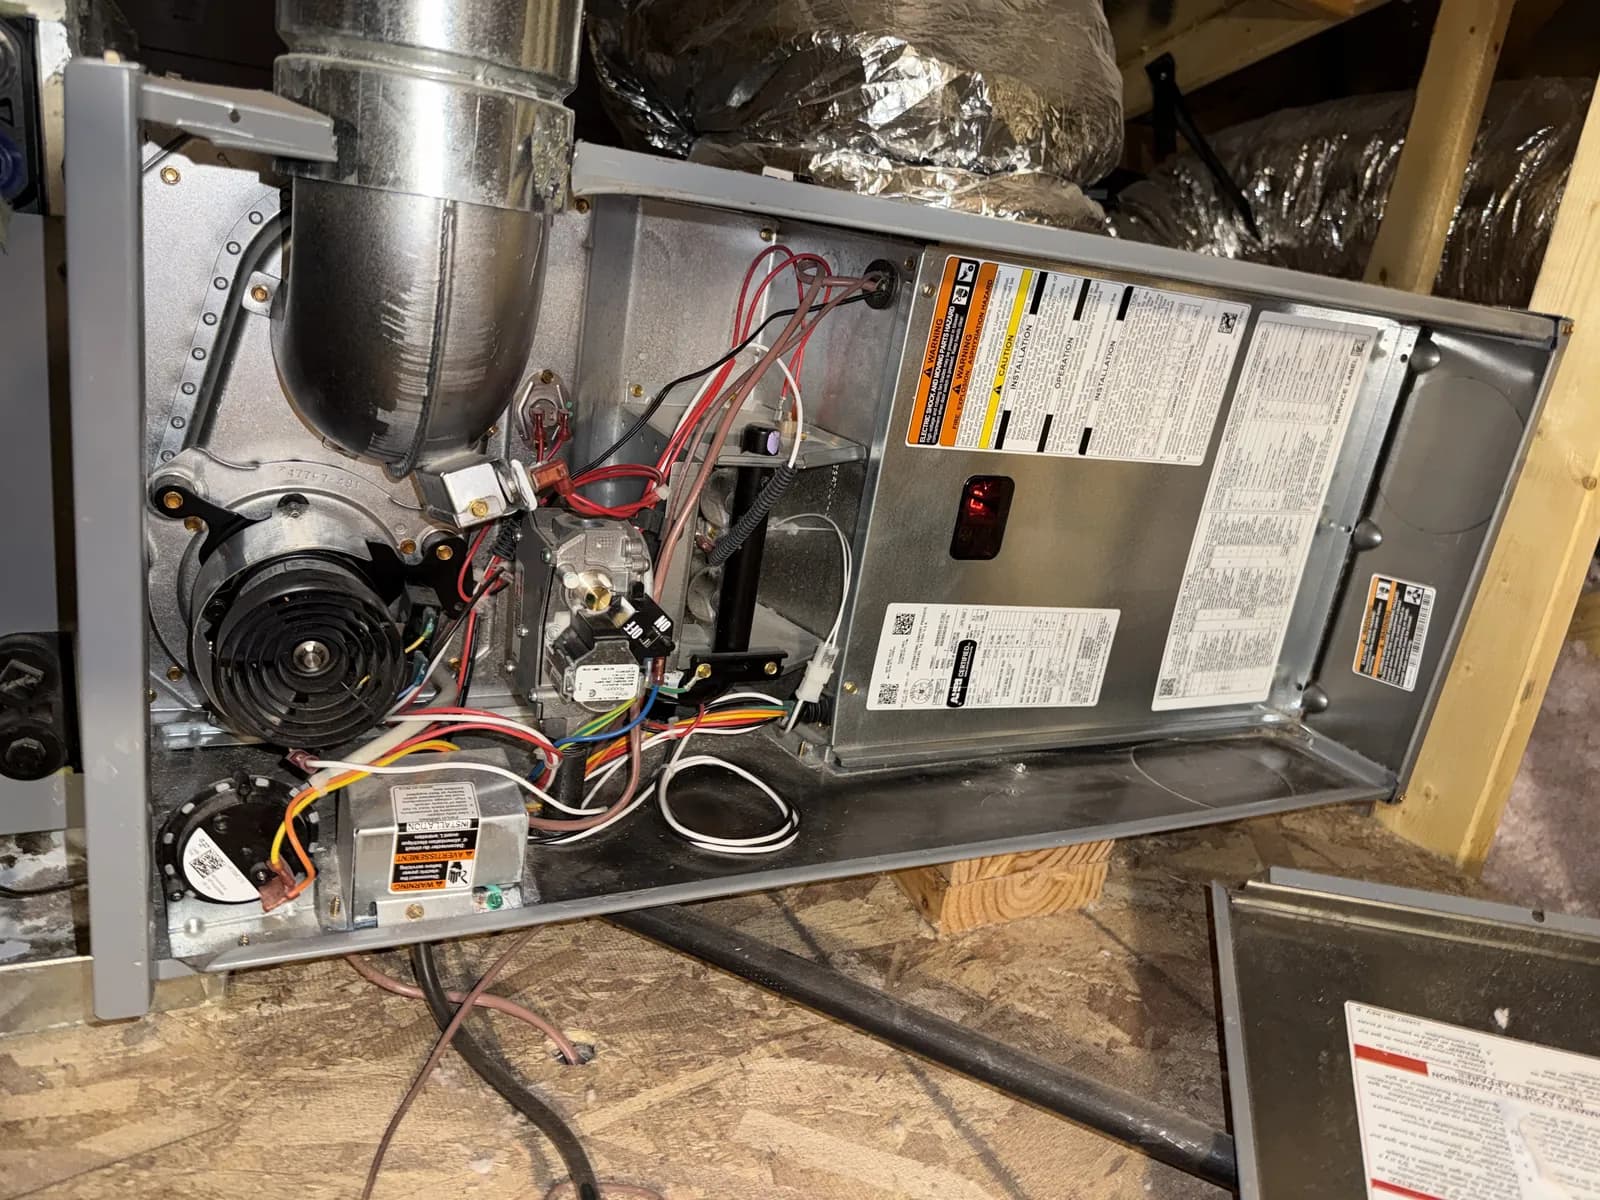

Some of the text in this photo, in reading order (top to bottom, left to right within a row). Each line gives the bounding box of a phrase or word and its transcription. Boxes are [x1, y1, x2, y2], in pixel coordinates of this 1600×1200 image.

[927, 318, 943, 363] WARNING
[967, 312, 984, 364] ASPHYXIATION
[980, 279, 992, 309] HAZARD
[919, 305, 955, 442] ELECTRIC SHOCK AND MOVING PARTS HAZARD
[956, 334, 972, 379] WARNING
[997, 334, 1013, 376] CAUTION
[1010, 324, 1032, 389] INSTALLATION
[1054, 336, 1073, 388] OPERATION
[1094, 340, 1116, 401] INSTALLATION
[1332, 357, 1357, 424] SERVICE LABEL
[622, 620, 643, 639] OFF
[653, 614, 671, 632] ON
[956, 645, 970, 676] CERTIFIED
[407, 821, 468, 830] INSTALLATION
[396, 852, 462, 861] AVERTISSEMENT
